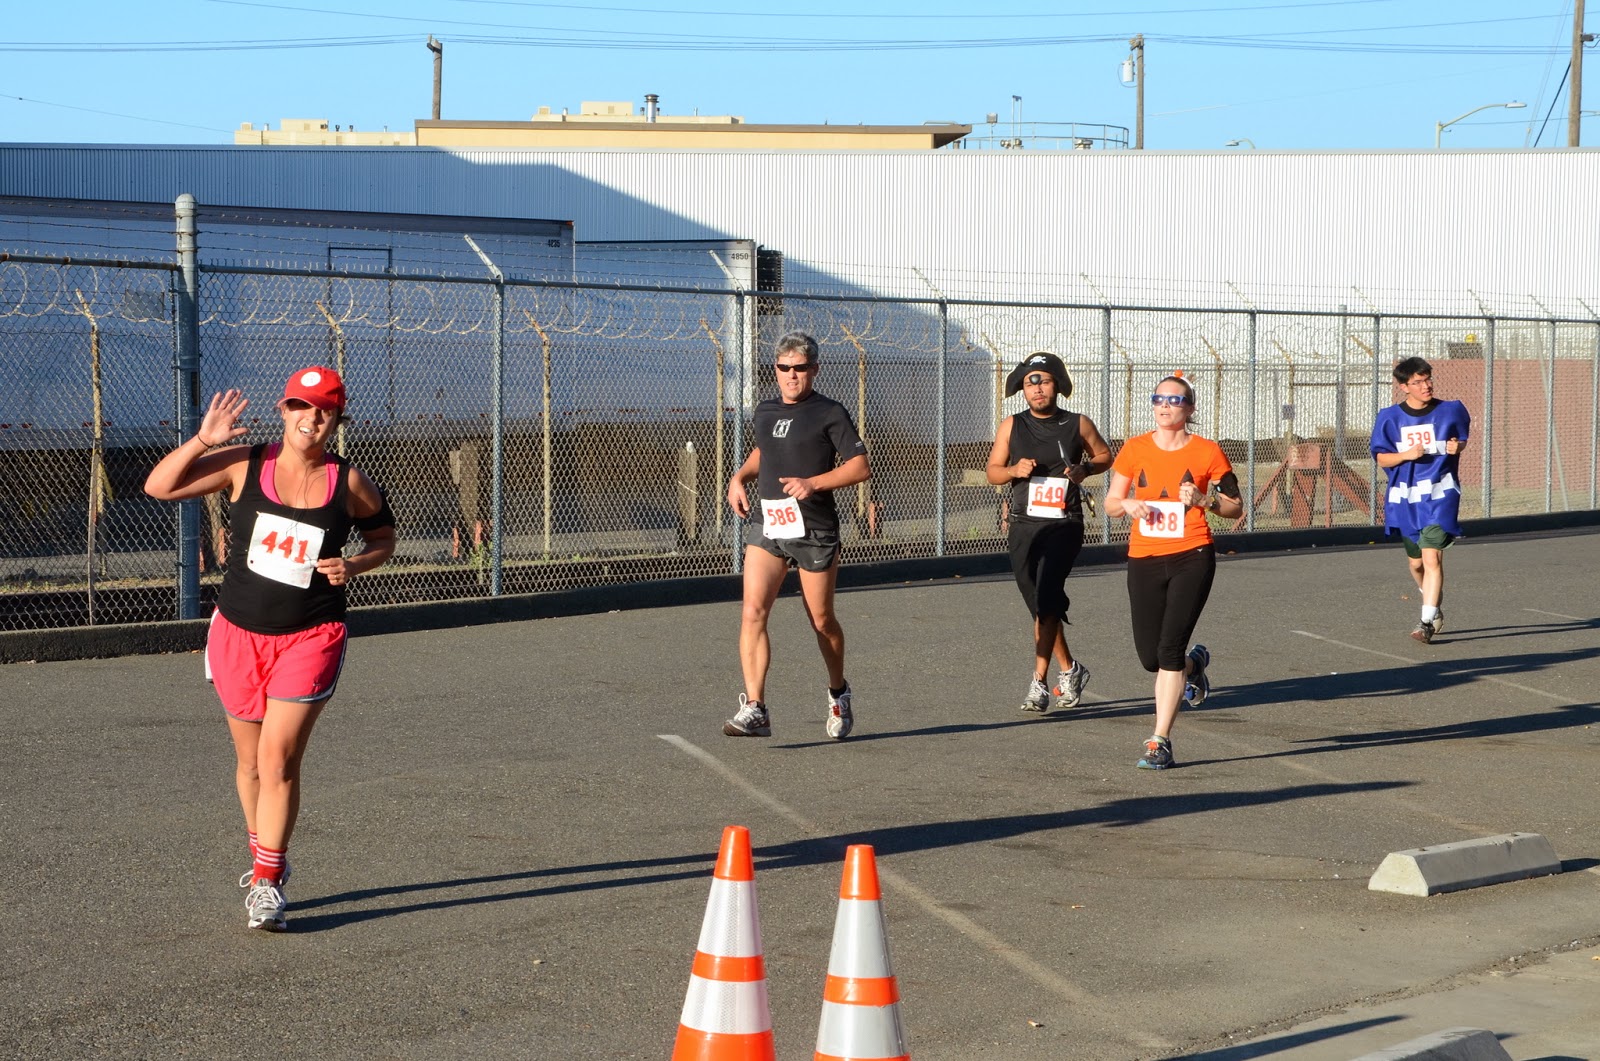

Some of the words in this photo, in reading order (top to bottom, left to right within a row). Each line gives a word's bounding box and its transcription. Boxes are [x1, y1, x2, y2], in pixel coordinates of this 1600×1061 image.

[731, 252, 749, 260] 4850
[1407, 431, 1431, 447] 539
[1034, 485, 1065, 504] 649
[767, 506, 797, 526] 586
[261, 530, 309, 565] 441
